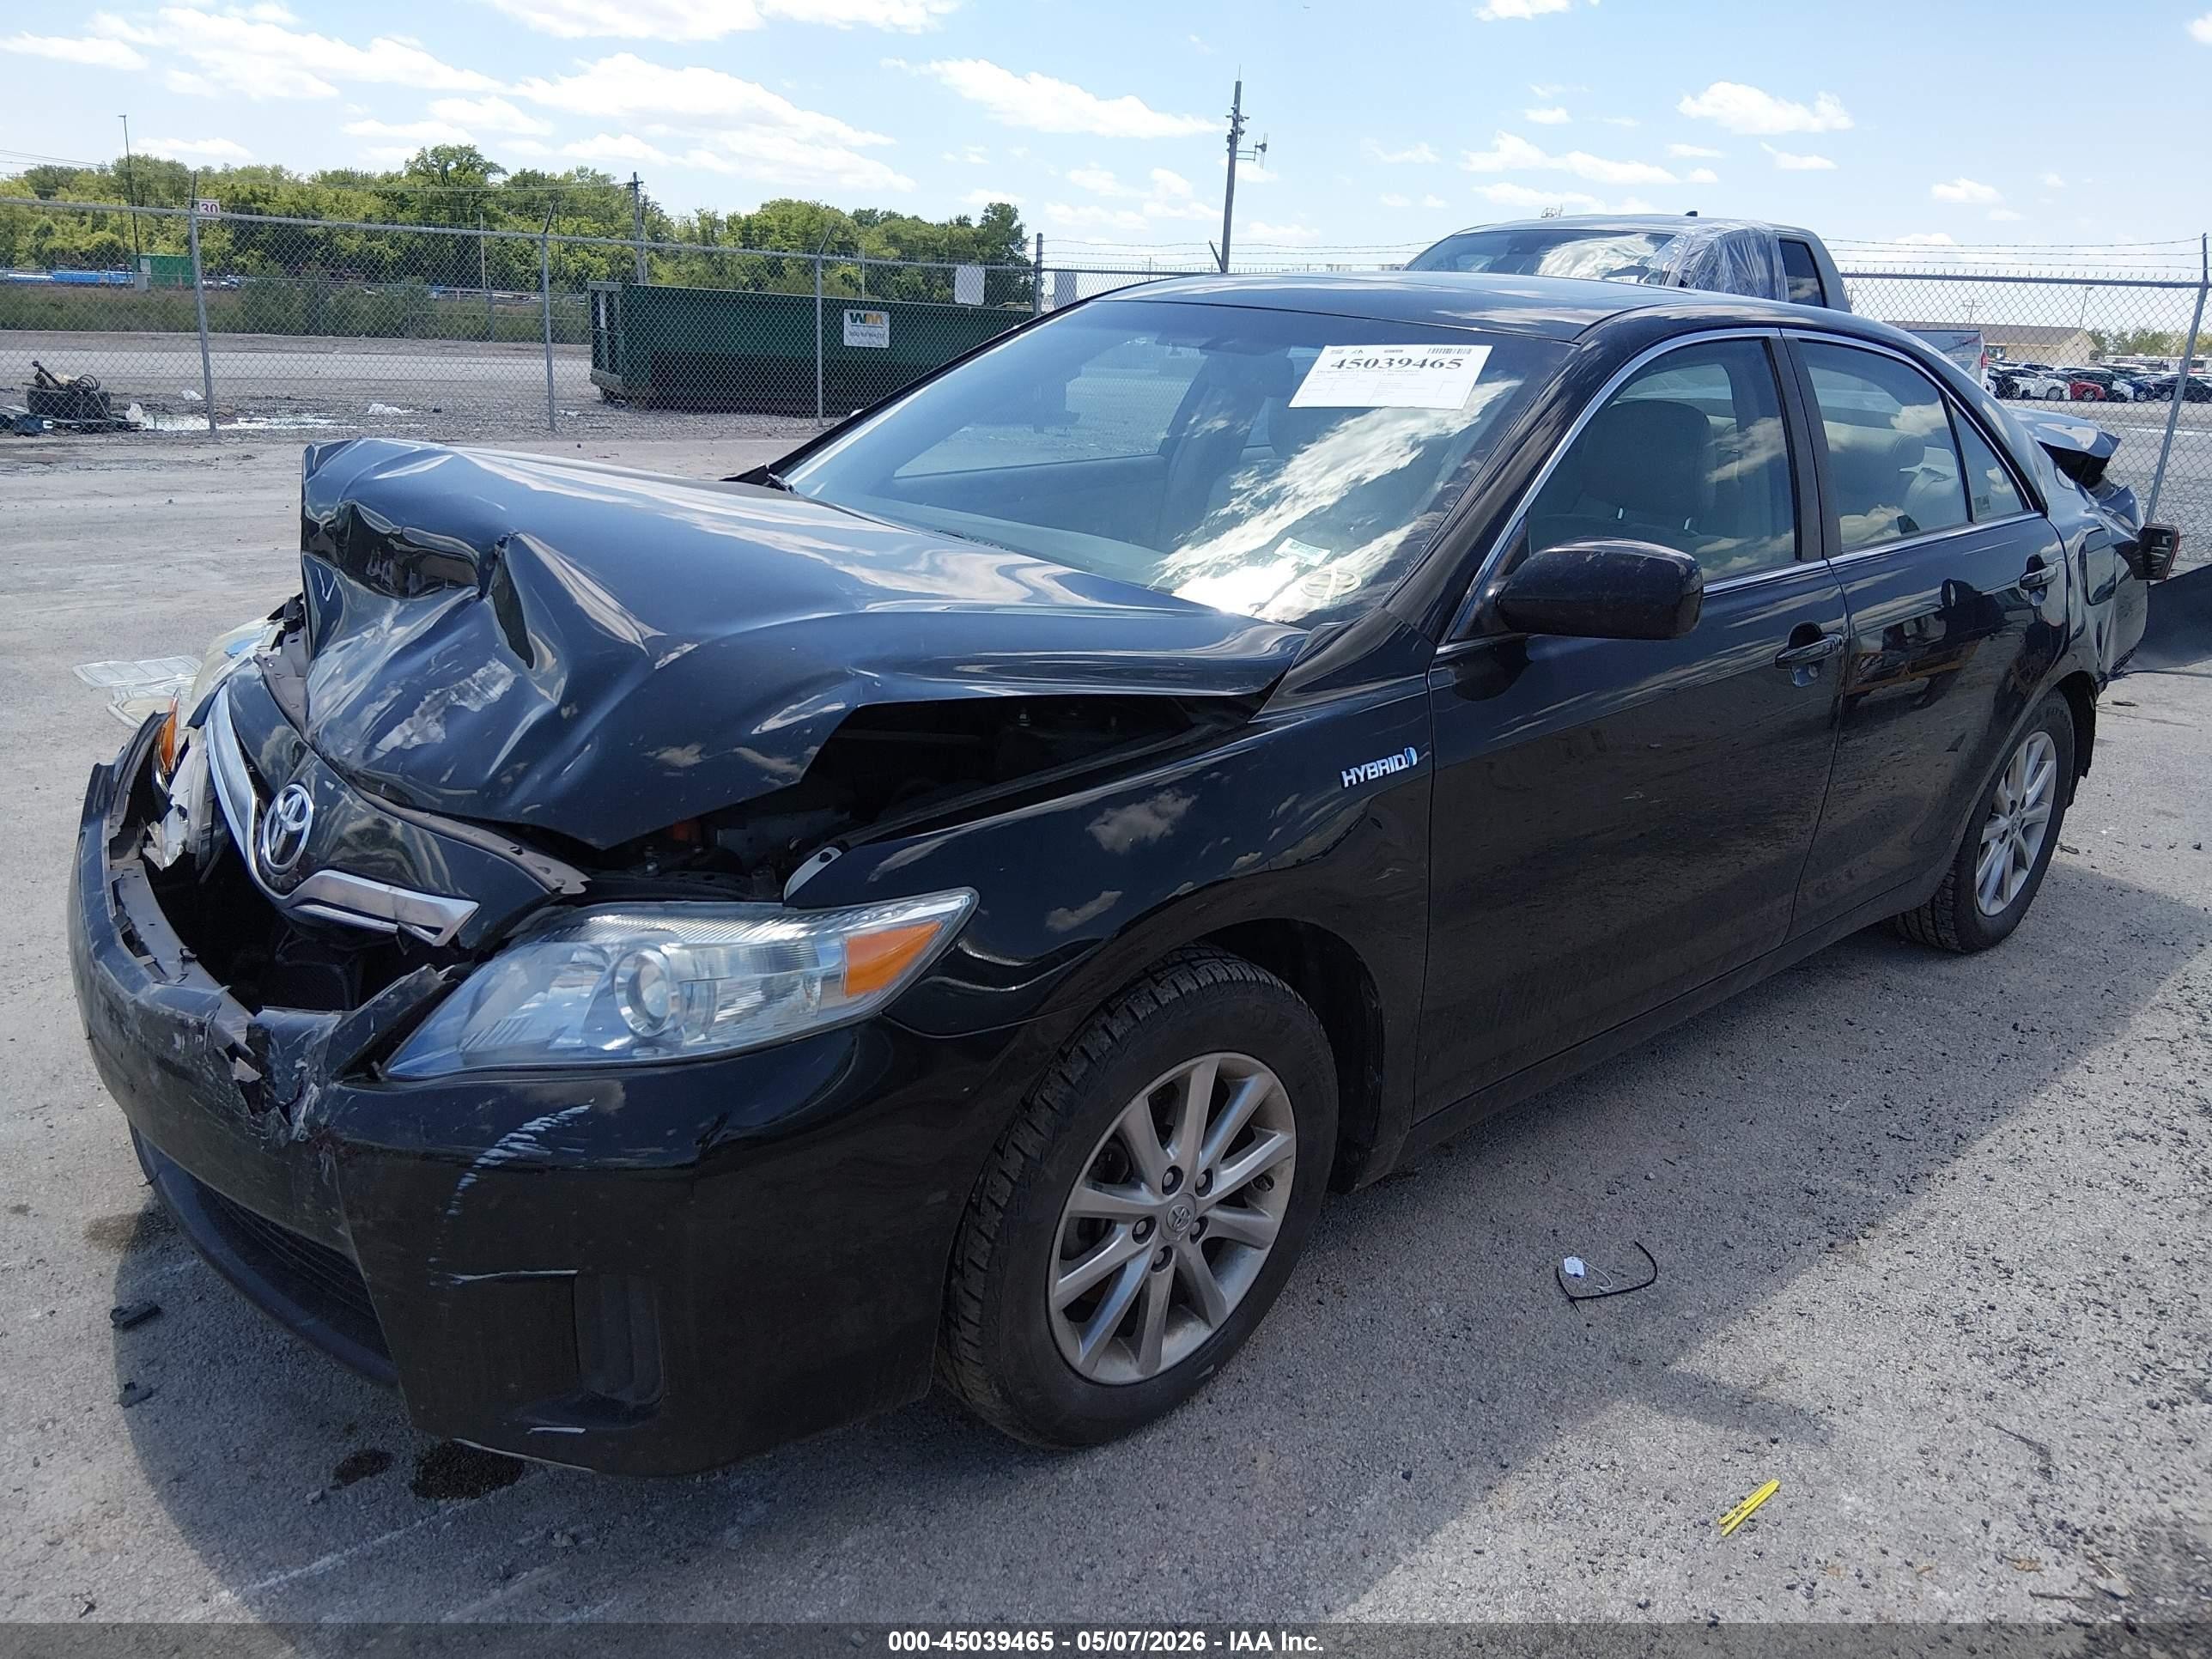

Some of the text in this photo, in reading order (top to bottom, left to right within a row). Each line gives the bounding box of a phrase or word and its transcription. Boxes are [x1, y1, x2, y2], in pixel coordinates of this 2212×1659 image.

[201, 203, 219, 215] 30
[1330, 357, 1465, 370] 45039465
[1341, 753, 1409, 788] HYBRID
